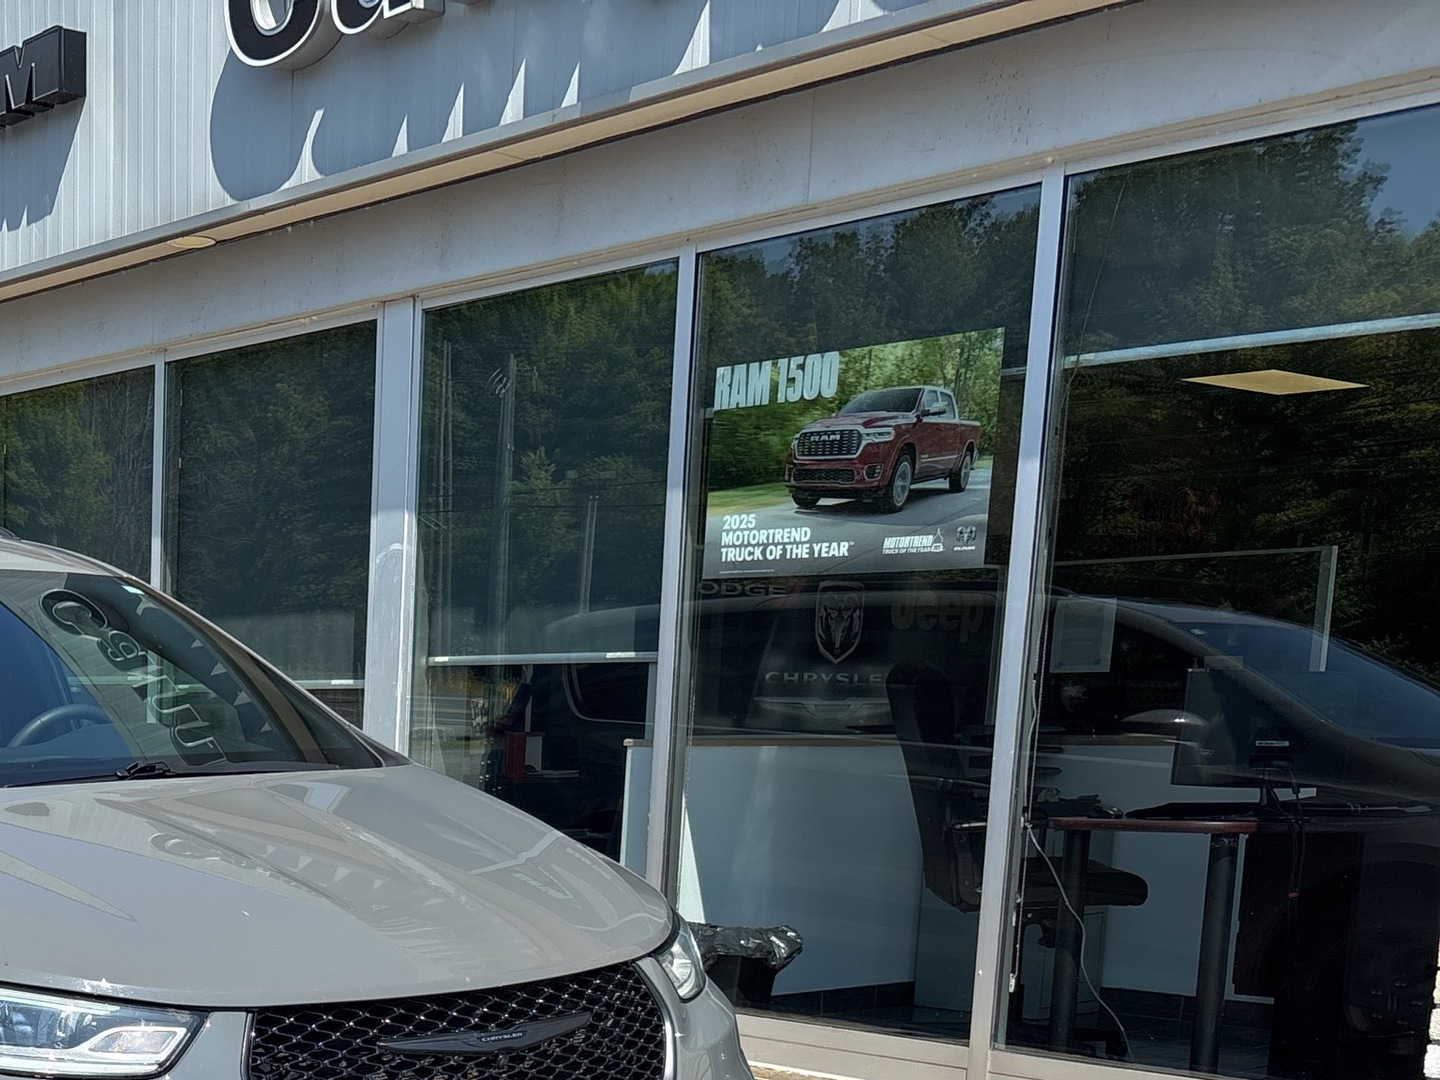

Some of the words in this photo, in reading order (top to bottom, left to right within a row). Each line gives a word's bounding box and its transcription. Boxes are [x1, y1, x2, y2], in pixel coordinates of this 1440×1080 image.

[713, 360, 773, 412] RAM
[777, 350, 840, 404] 1500
[810, 434, 841, 442] RAM
[722, 514, 756, 530] 2025
[721, 527, 811, 546] MOTORTREND
[882, 534, 934, 549] MOTORTREND
[721, 545, 763, 562] TRUCK
[766, 546, 783, 560] OF
[785, 544, 810, 559] THE
[764, 671, 884, 686] CHRYSLE
[481, 1032, 523, 1042] CHRYSLER
